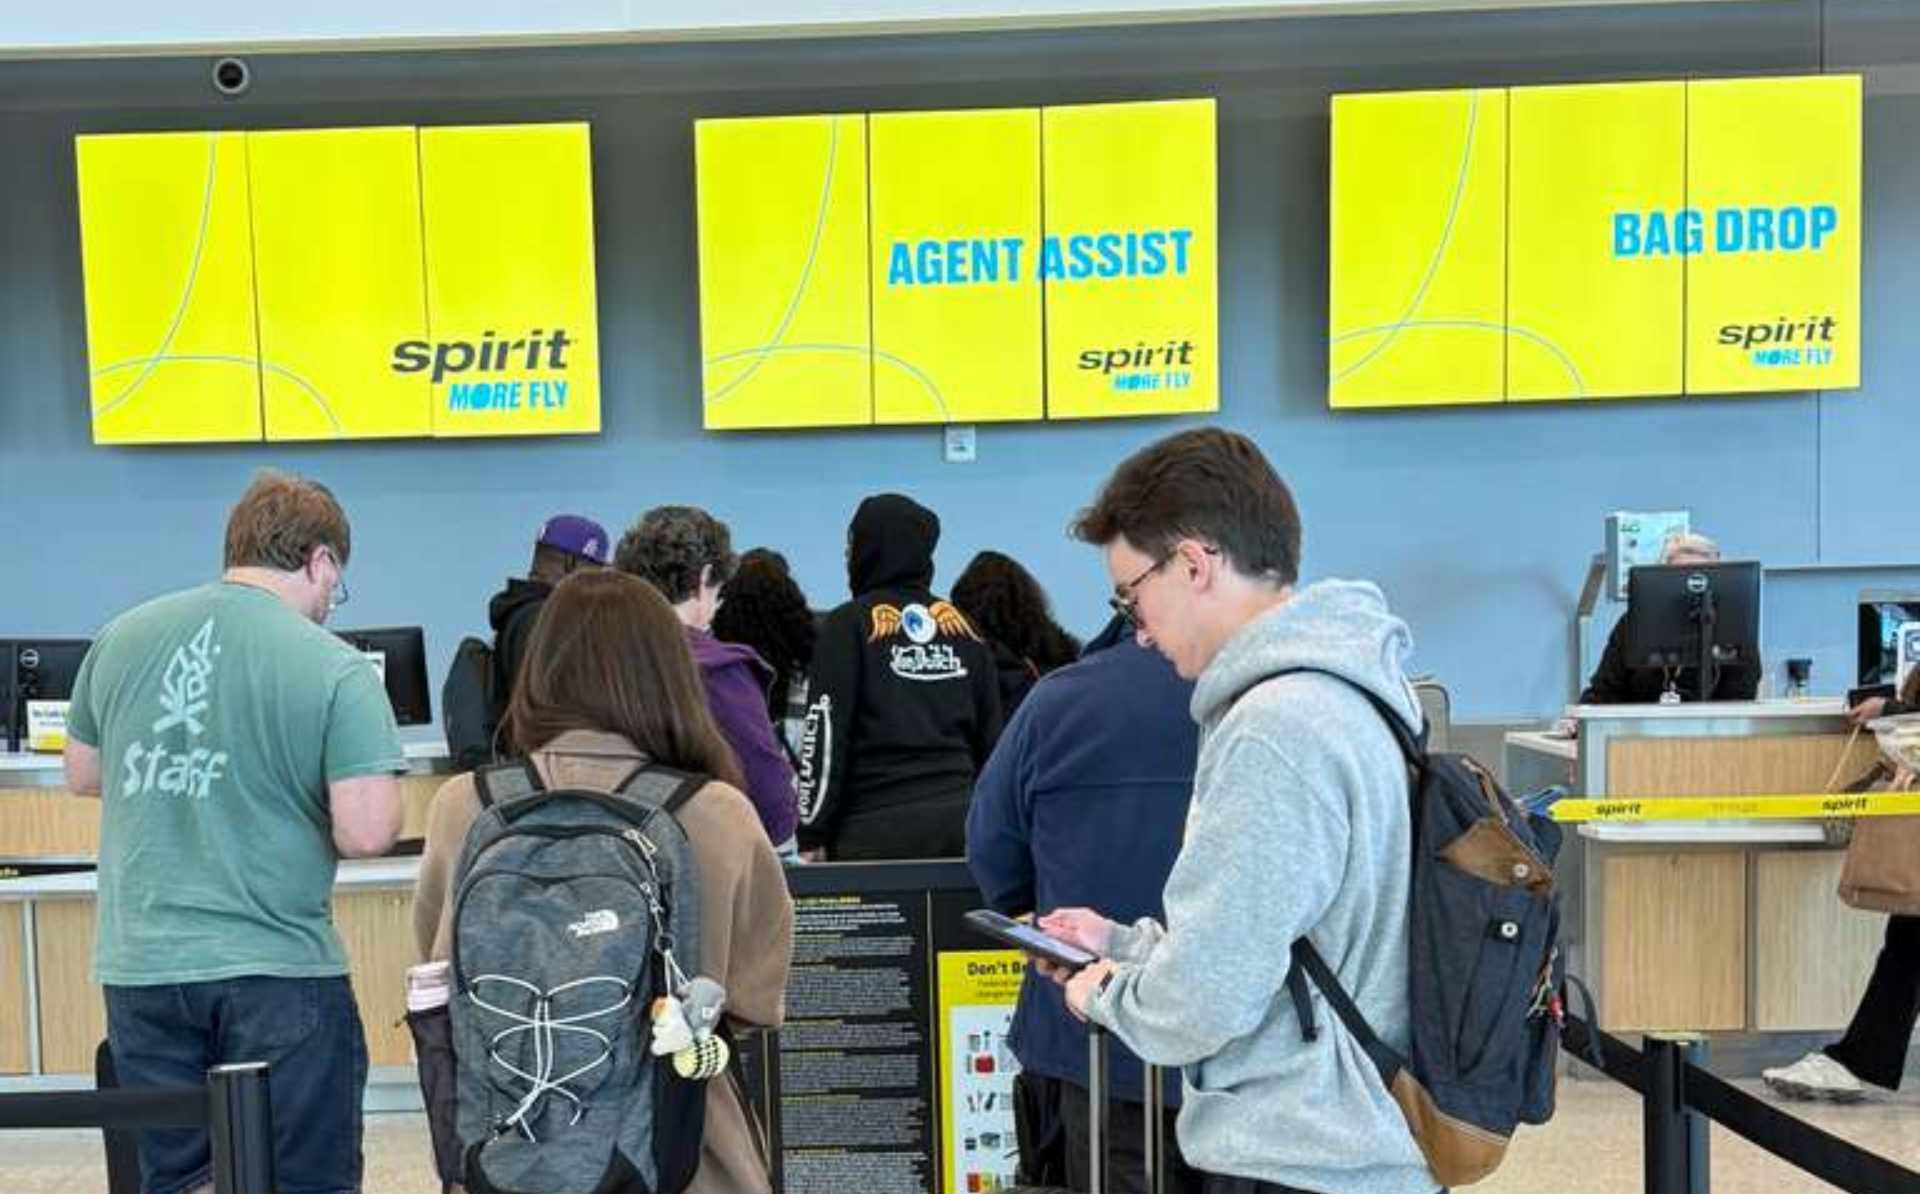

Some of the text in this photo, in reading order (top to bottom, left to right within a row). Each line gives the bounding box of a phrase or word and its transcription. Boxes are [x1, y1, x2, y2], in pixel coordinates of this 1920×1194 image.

[1613, 205, 1837, 256] BAG DROP
[888, 230, 1193, 286] AGENT ASSIST
[1717, 316, 1836, 350] spirit
[391, 328, 573, 384] spirit
[1077, 340, 1194, 374] spirit
[1754, 349, 1801, 366] MORE
[449, 381, 568, 411] MORE FLY
[1113, 372, 1161, 391] MORE
[123, 741, 229, 799] Staff
[1596, 801, 1641, 818] spirit
[1821, 796, 1868, 811] spirit
[966, 961, 1008, 976] Don't
